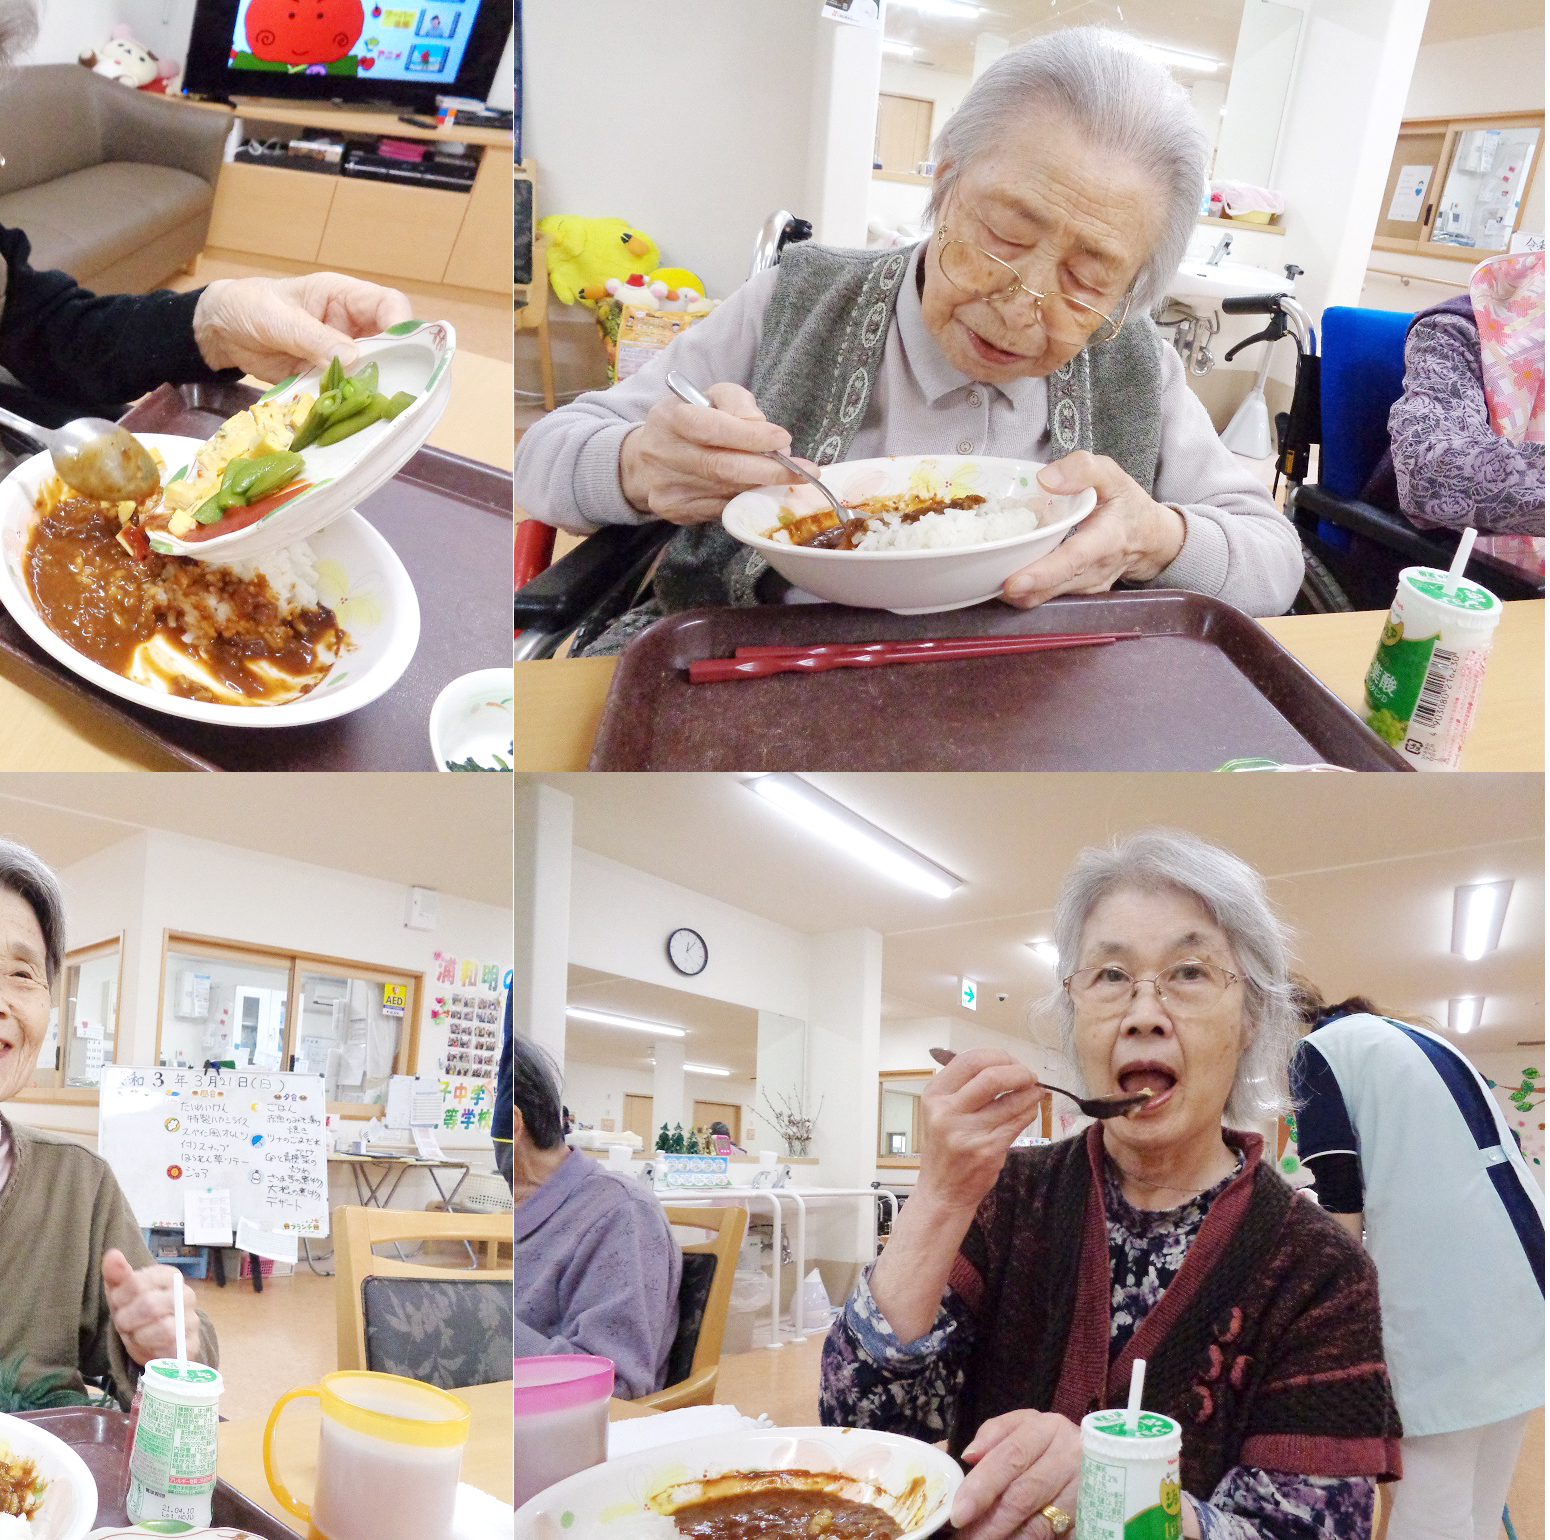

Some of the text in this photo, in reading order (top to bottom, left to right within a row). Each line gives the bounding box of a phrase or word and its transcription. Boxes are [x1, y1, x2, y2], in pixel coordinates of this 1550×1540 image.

[386, 996, 403, 1005] AED
[267, 1103, 297, 1114] ごはん
[266, 1196, 302, 1211] デザート
[162, 1503, 194, 1514] 21.04.10
